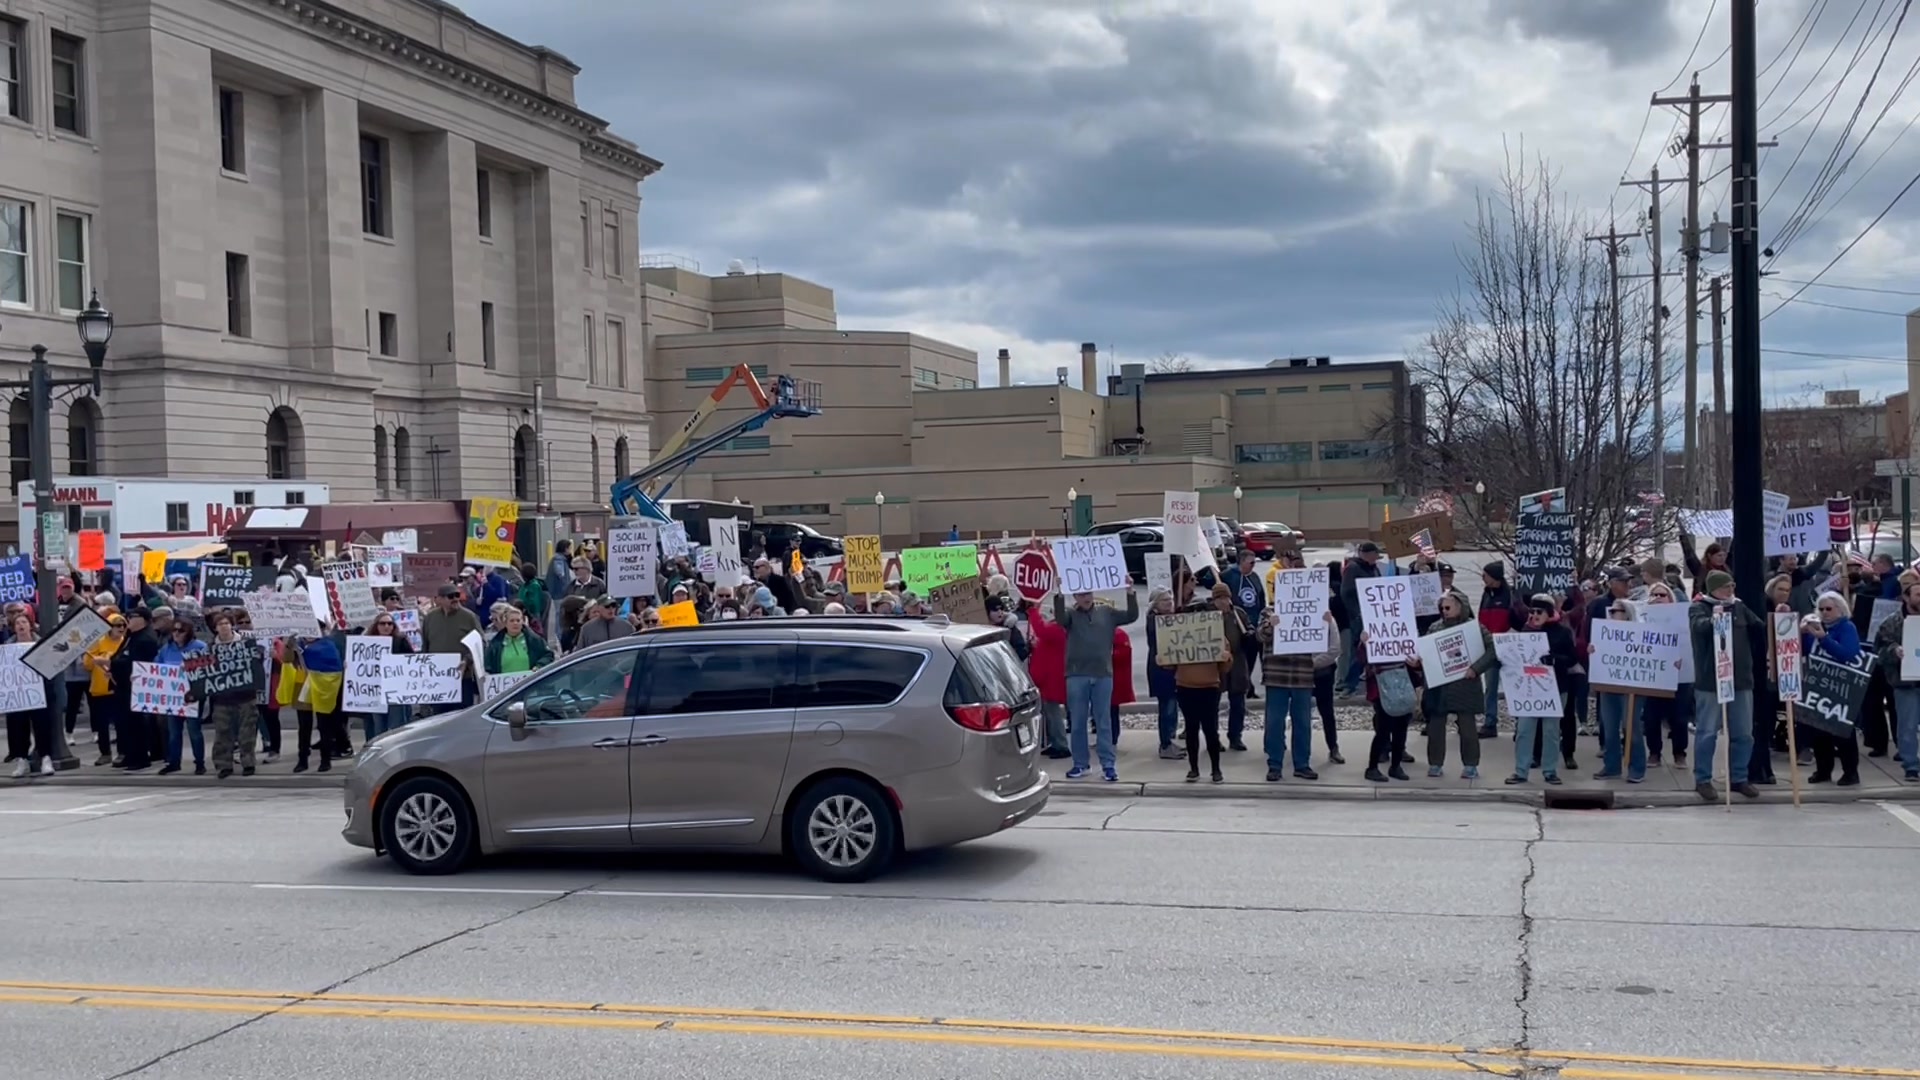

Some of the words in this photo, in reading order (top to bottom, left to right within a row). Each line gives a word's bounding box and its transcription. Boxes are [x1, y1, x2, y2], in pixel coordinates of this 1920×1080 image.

[1516, 514, 1526, 528] I
[1533, 513, 1576, 526] THOUGHT
[1780, 511, 1814, 528] ANDS
[615, 532, 648, 542] SOCIAL
[847, 536, 879, 553] STOP
[1781, 533, 1806, 548] OFF
[612, 543, 652, 554] SECURITY
[1057, 536, 1116, 560] TARIFFS
[619, 564, 646, 572] PONZI
[848, 552, 881, 568] MUSK
[1543, 556, 1574, 569] WOULD
[207, 567, 253, 577] HANDS
[337, 568, 366, 581] LOVE
[619, 573, 646, 582] SCHEME
[848, 569, 883, 585] TRUMP
[1015, 561, 1049, 591] ELON
[1065, 565, 1121, 592] DUMB
[1278, 571, 1303, 585] VETS
[1307, 569, 1327, 583] ARE
[223, 577, 252, 589] OFF
[1516, 574, 1535, 590] PAY
[1543, 573, 1574, 588] MORE
[1291, 585, 1311, 599] NOT
[1365, 583, 1405, 602] STOP
[1371, 602, 1401, 618] THE
[1291, 615, 1312, 628] AND
[1169, 625, 1222, 646] JAIL
[1369, 621, 1409, 639] MAGA
[1600, 625, 1636, 643] PUBLIC
[1642, 631, 1679, 647] HEALTH
[1368, 639, 1416, 657] TAKEOVER
[1625, 643, 1653, 655] OVER
[403, 654, 435, 665] THE
[1601, 653, 1667, 671] CORPORATE
[1781, 655, 1795, 672] OFF
[356, 662, 382, 678] OUR
[1608, 668, 1656, 682] WEALTH
[141, 676, 163, 690] FOR
[170, 680, 186, 693] VA
[204, 668, 254, 695] AGAIN
[1779, 672, 1799, 693] GAZA
[1513, 699, 1556, 712] DOOM
[1798, 690, 1855, 726] EGAL
